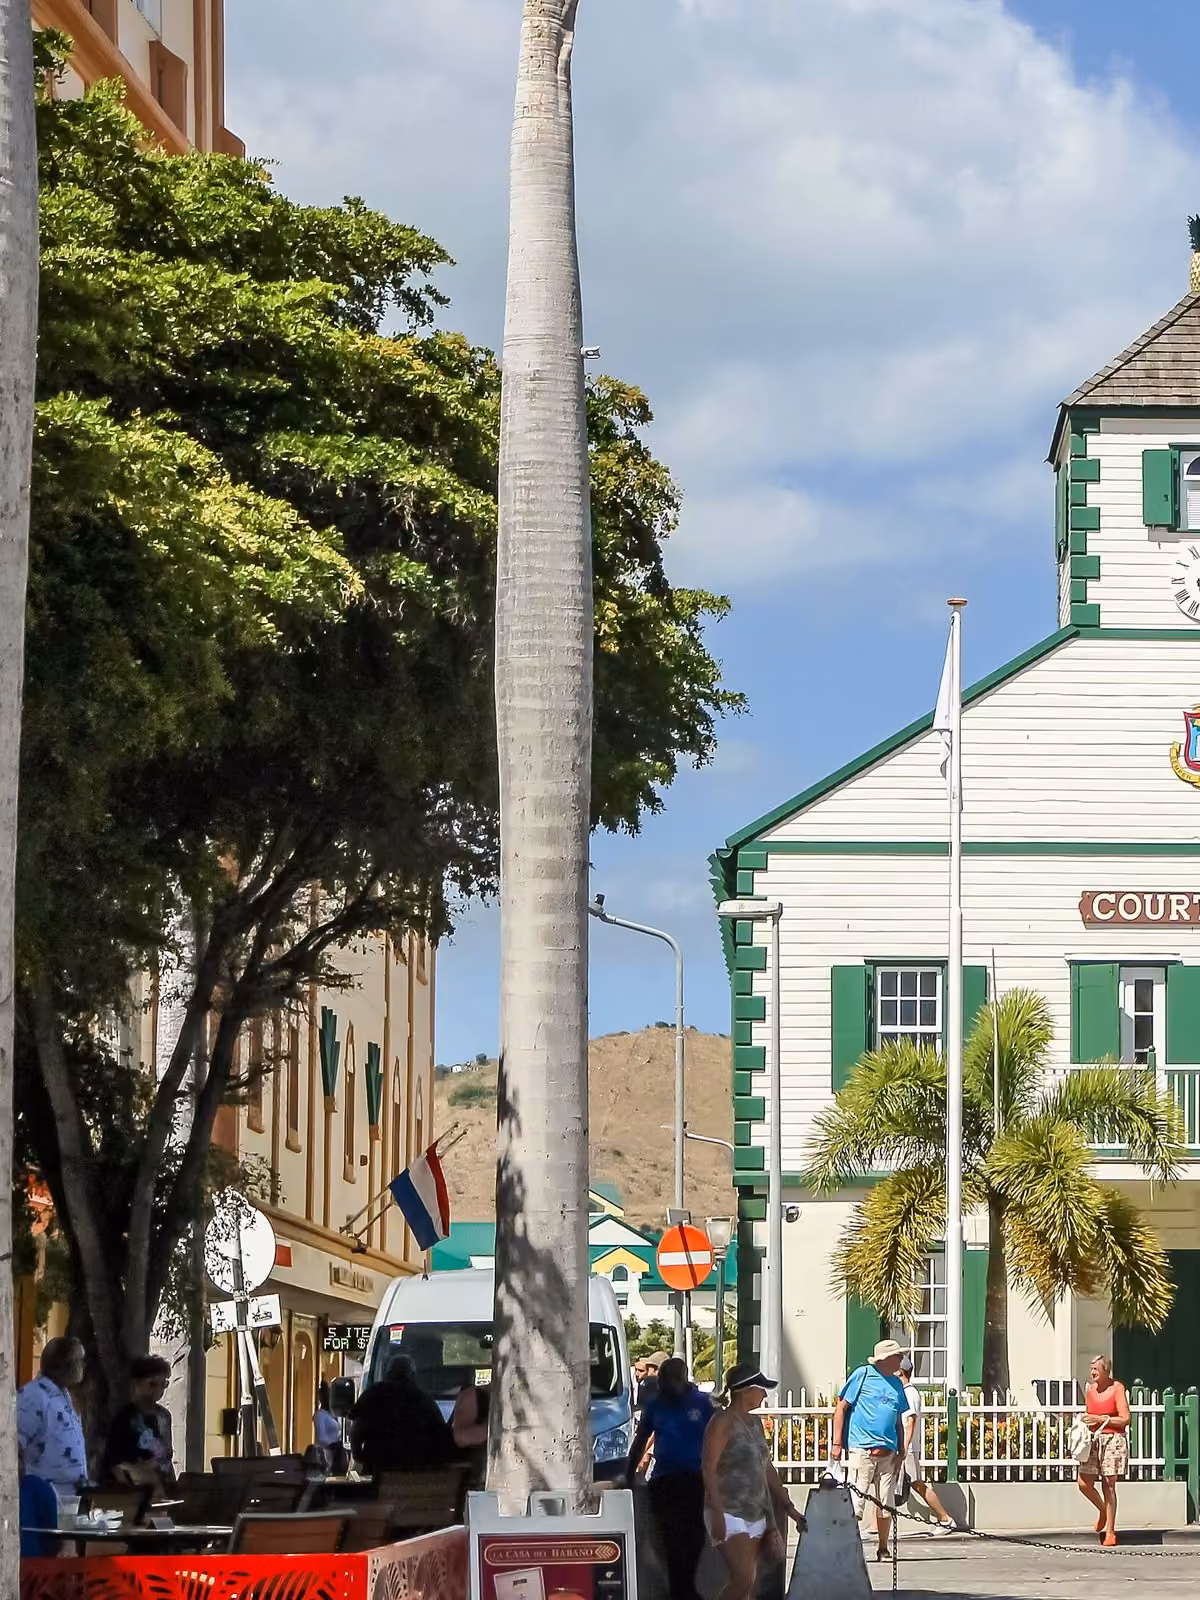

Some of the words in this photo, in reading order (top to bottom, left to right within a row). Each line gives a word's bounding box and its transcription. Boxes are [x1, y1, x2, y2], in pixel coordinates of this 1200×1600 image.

[328, 1327, 337, 1338] 5
[323, 1338, 349, 1350] FOR
[505, 1550, 530, 1559] CASA
[552, 1548, 593, 1558] HABANO
